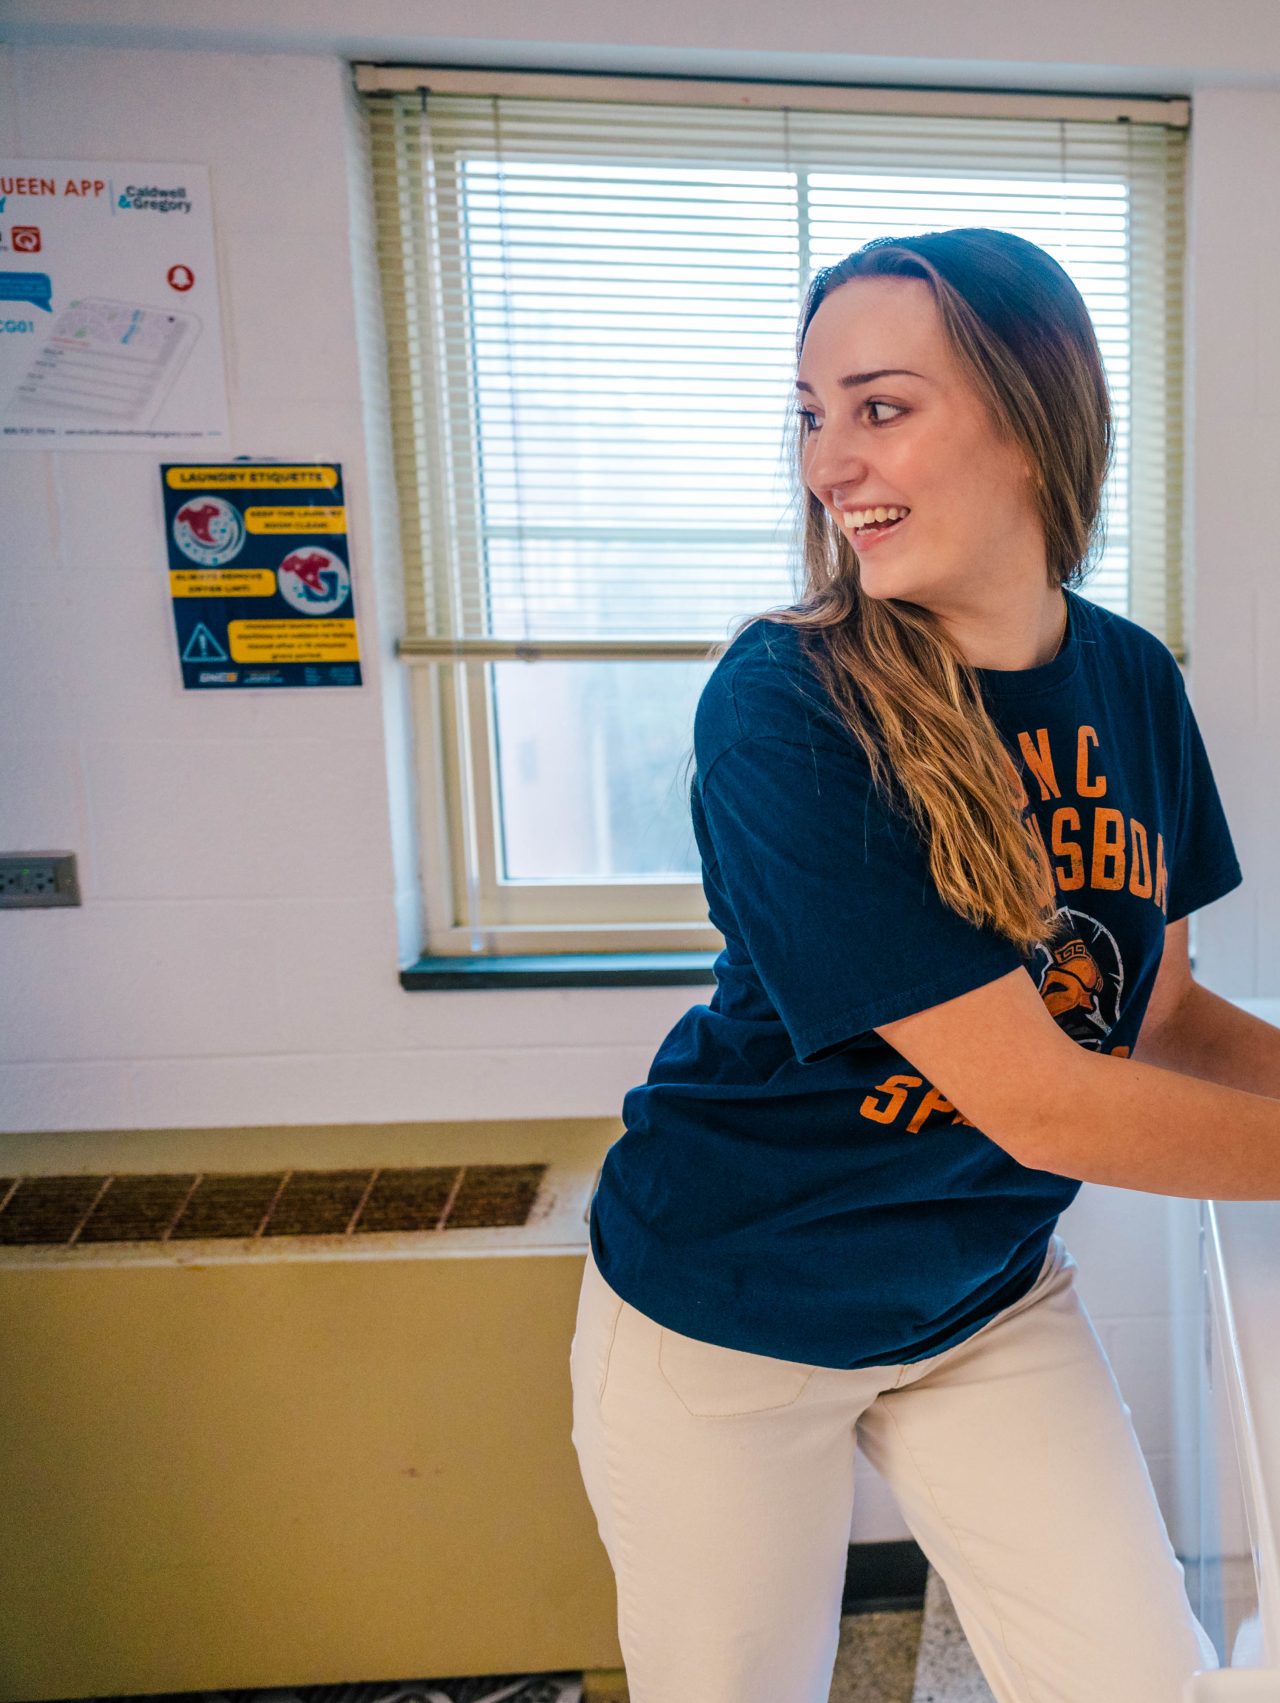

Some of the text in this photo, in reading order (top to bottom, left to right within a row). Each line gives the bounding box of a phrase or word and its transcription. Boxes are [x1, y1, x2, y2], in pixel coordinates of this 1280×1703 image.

[0, 178, 104, 197] UEEN APP
[126, 185, 186, 197] Caldwell
[180, 471, 322, 484] LAUNDRY ETIQUETTE
[1003, 725, 1106, 808] NC
